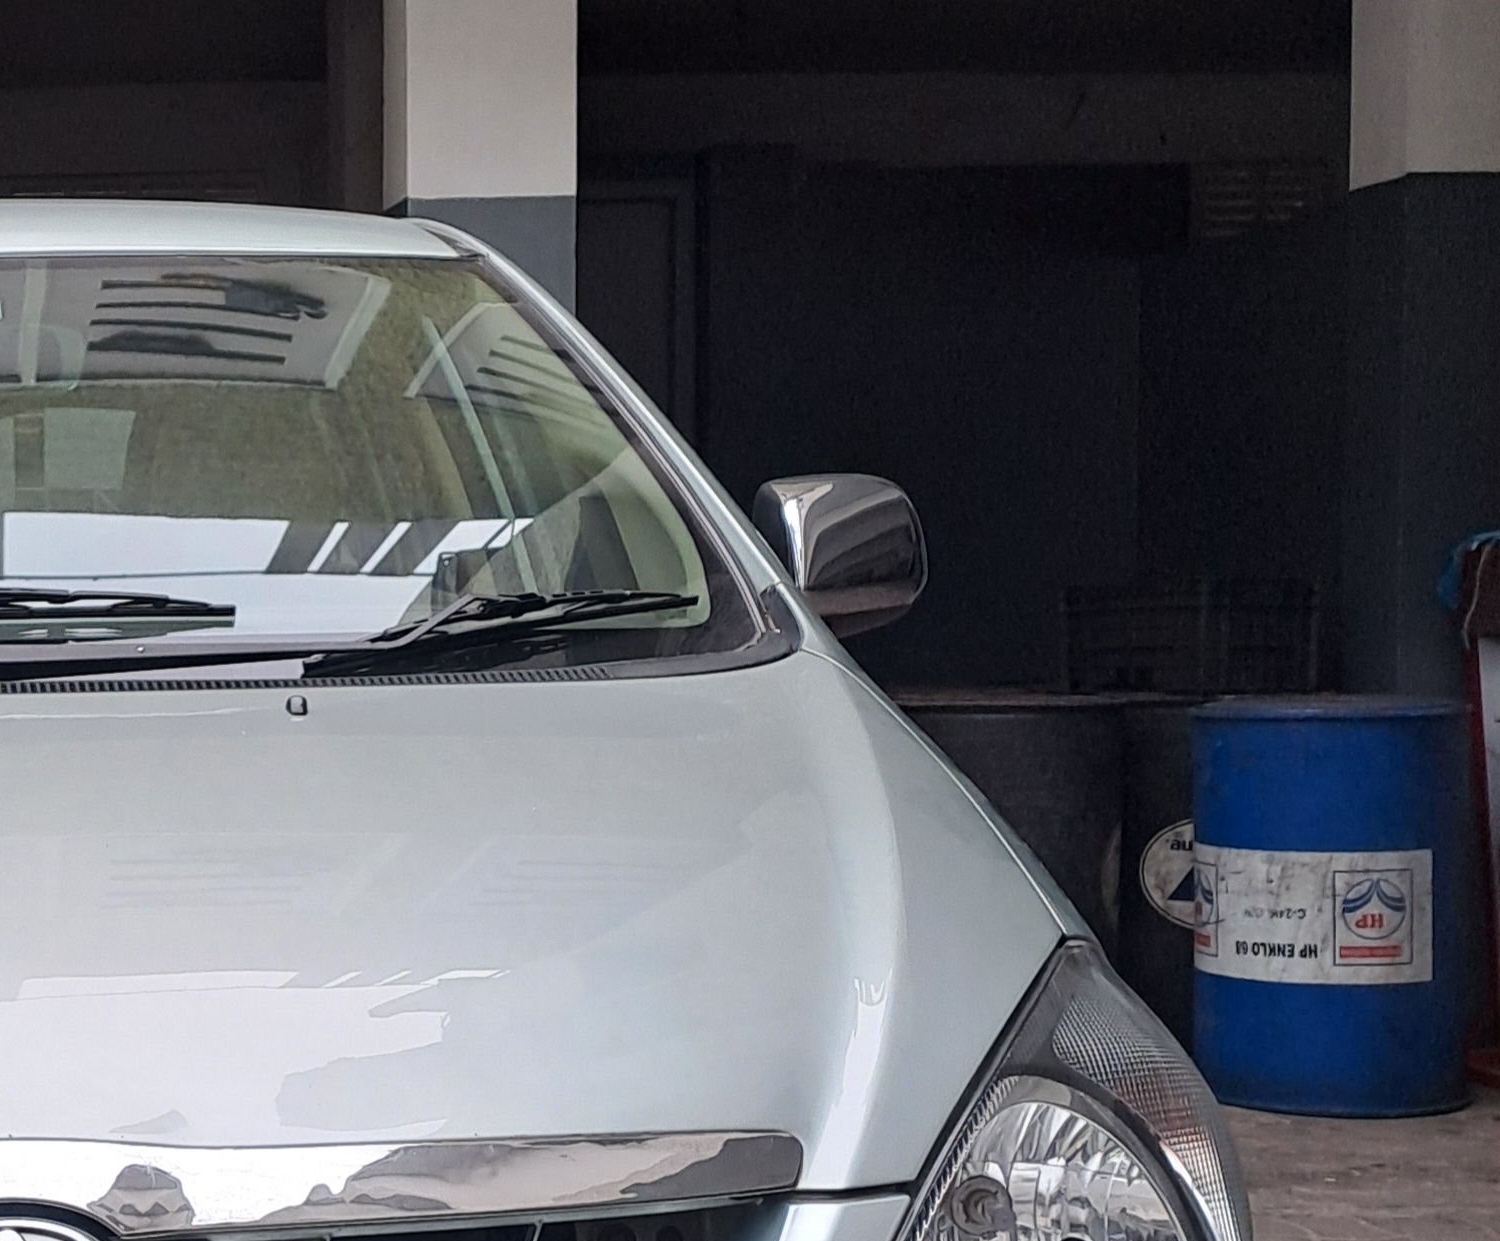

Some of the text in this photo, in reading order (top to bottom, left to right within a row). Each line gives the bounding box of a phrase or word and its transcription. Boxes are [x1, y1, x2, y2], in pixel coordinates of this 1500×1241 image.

[1354, 913, 1384, 929] HP
[1251, 941, 1296, 959] ENKLO
[1298, 943, 1318, 959] HP
